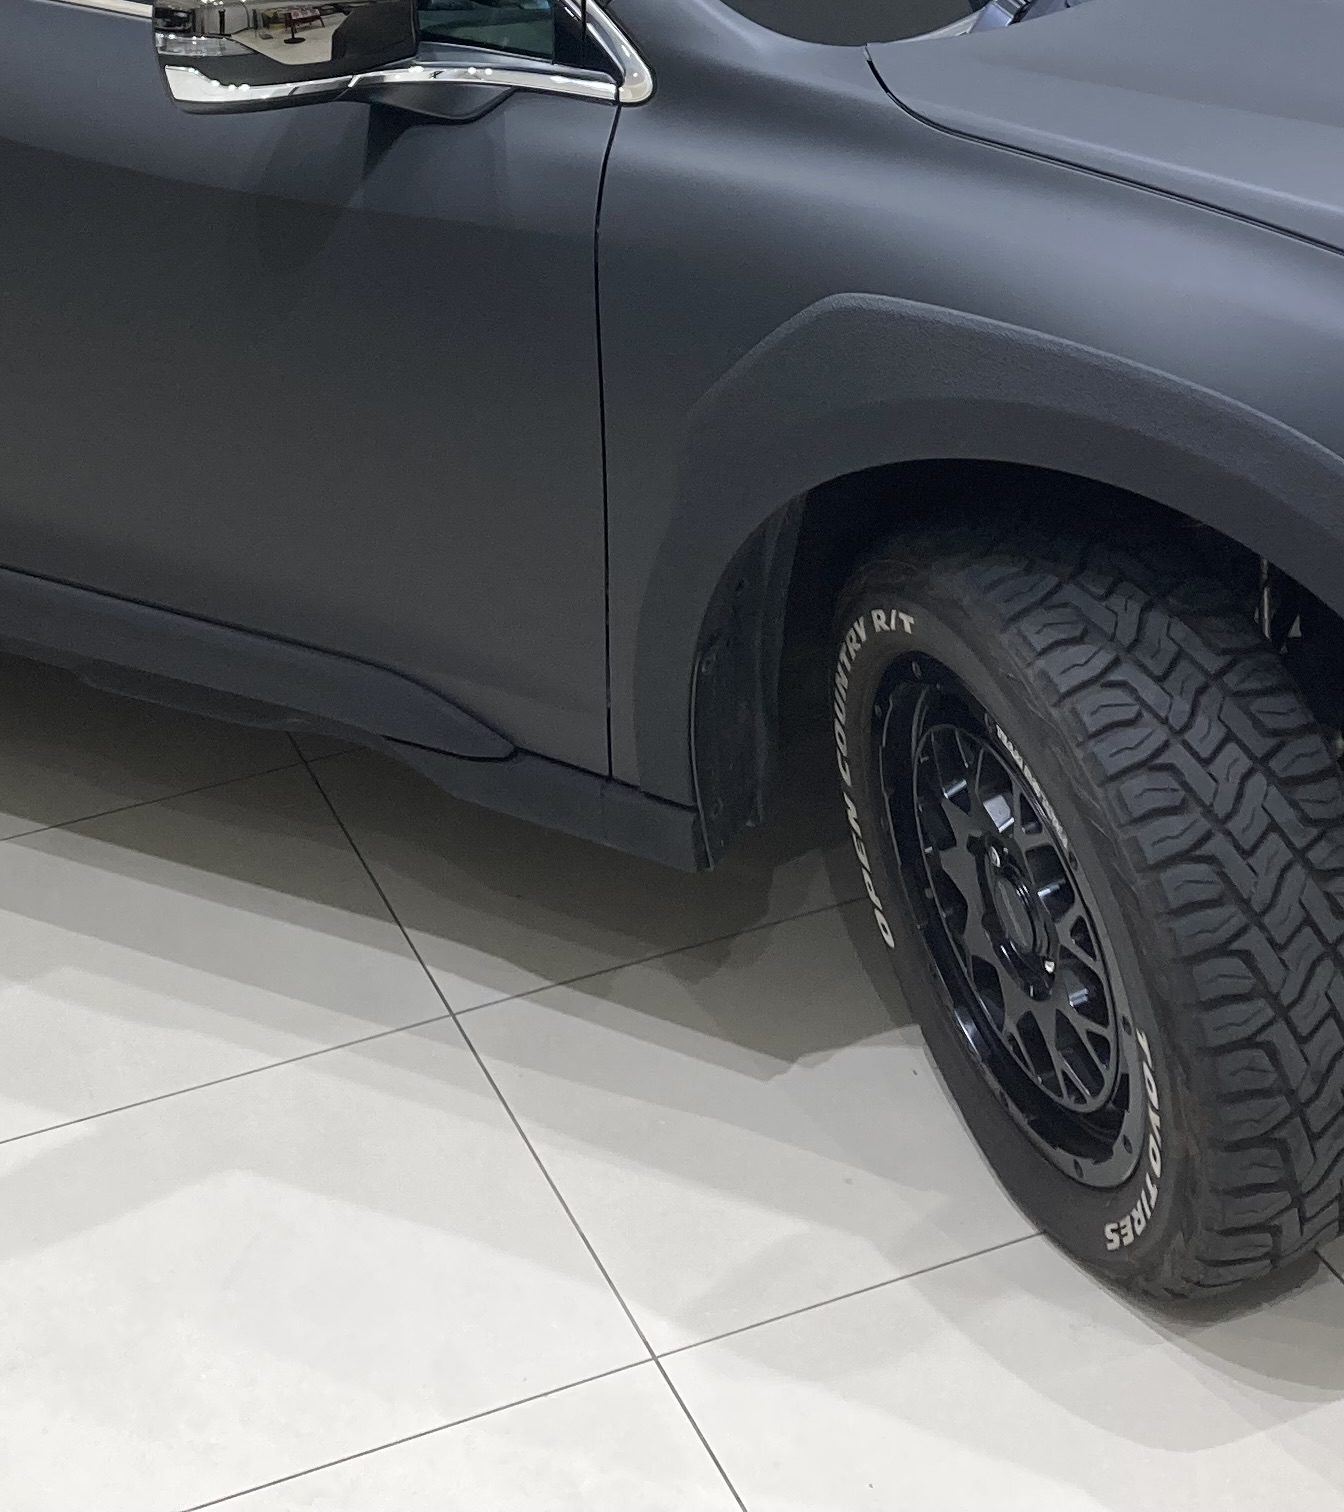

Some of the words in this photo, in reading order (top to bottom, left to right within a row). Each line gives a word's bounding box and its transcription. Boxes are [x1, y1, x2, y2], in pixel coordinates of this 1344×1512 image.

[870, 608, 916, 635] R/T
[834, 615, 868, 788] COUNTRY
[843, 791, 895, 949] OPEN
[1135, 1027, 1162, 1179] TOYO
[1104, 1172, 1159, 1251] TIRES
